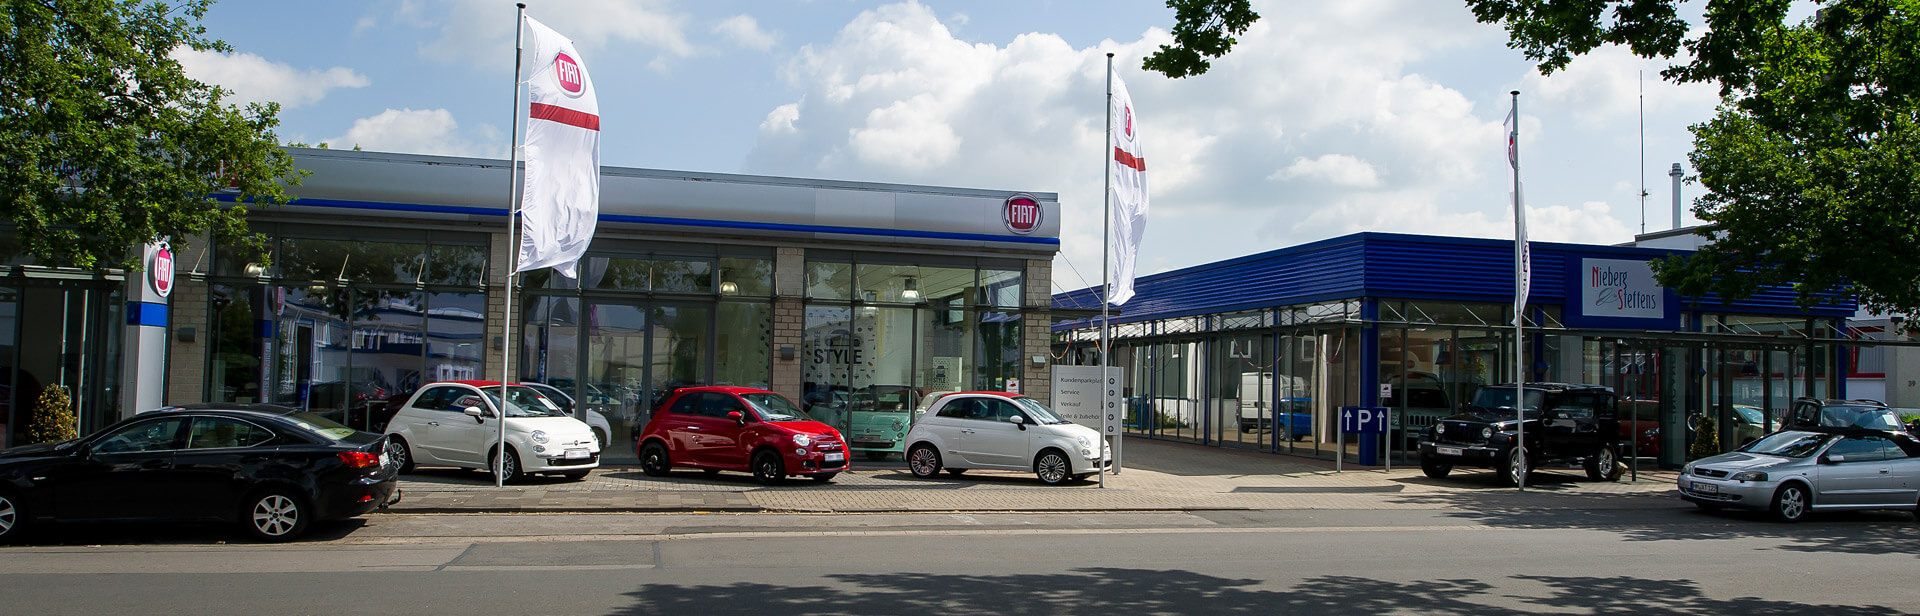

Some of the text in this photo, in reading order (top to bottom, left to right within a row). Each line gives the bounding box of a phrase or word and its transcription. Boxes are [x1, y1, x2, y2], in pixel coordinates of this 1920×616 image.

[559, 59, 580, 85] FIAT
[1011, 204, 1035, 224] FIAT
[157, 256, 170, 282] FIAT
[1591, 265, 1628, 290] Nieberg
[1617, 289, 1657, 310] Steffens
[813, 349, 862, 365] STYLE
[1357, 409, 1372, 431] P
